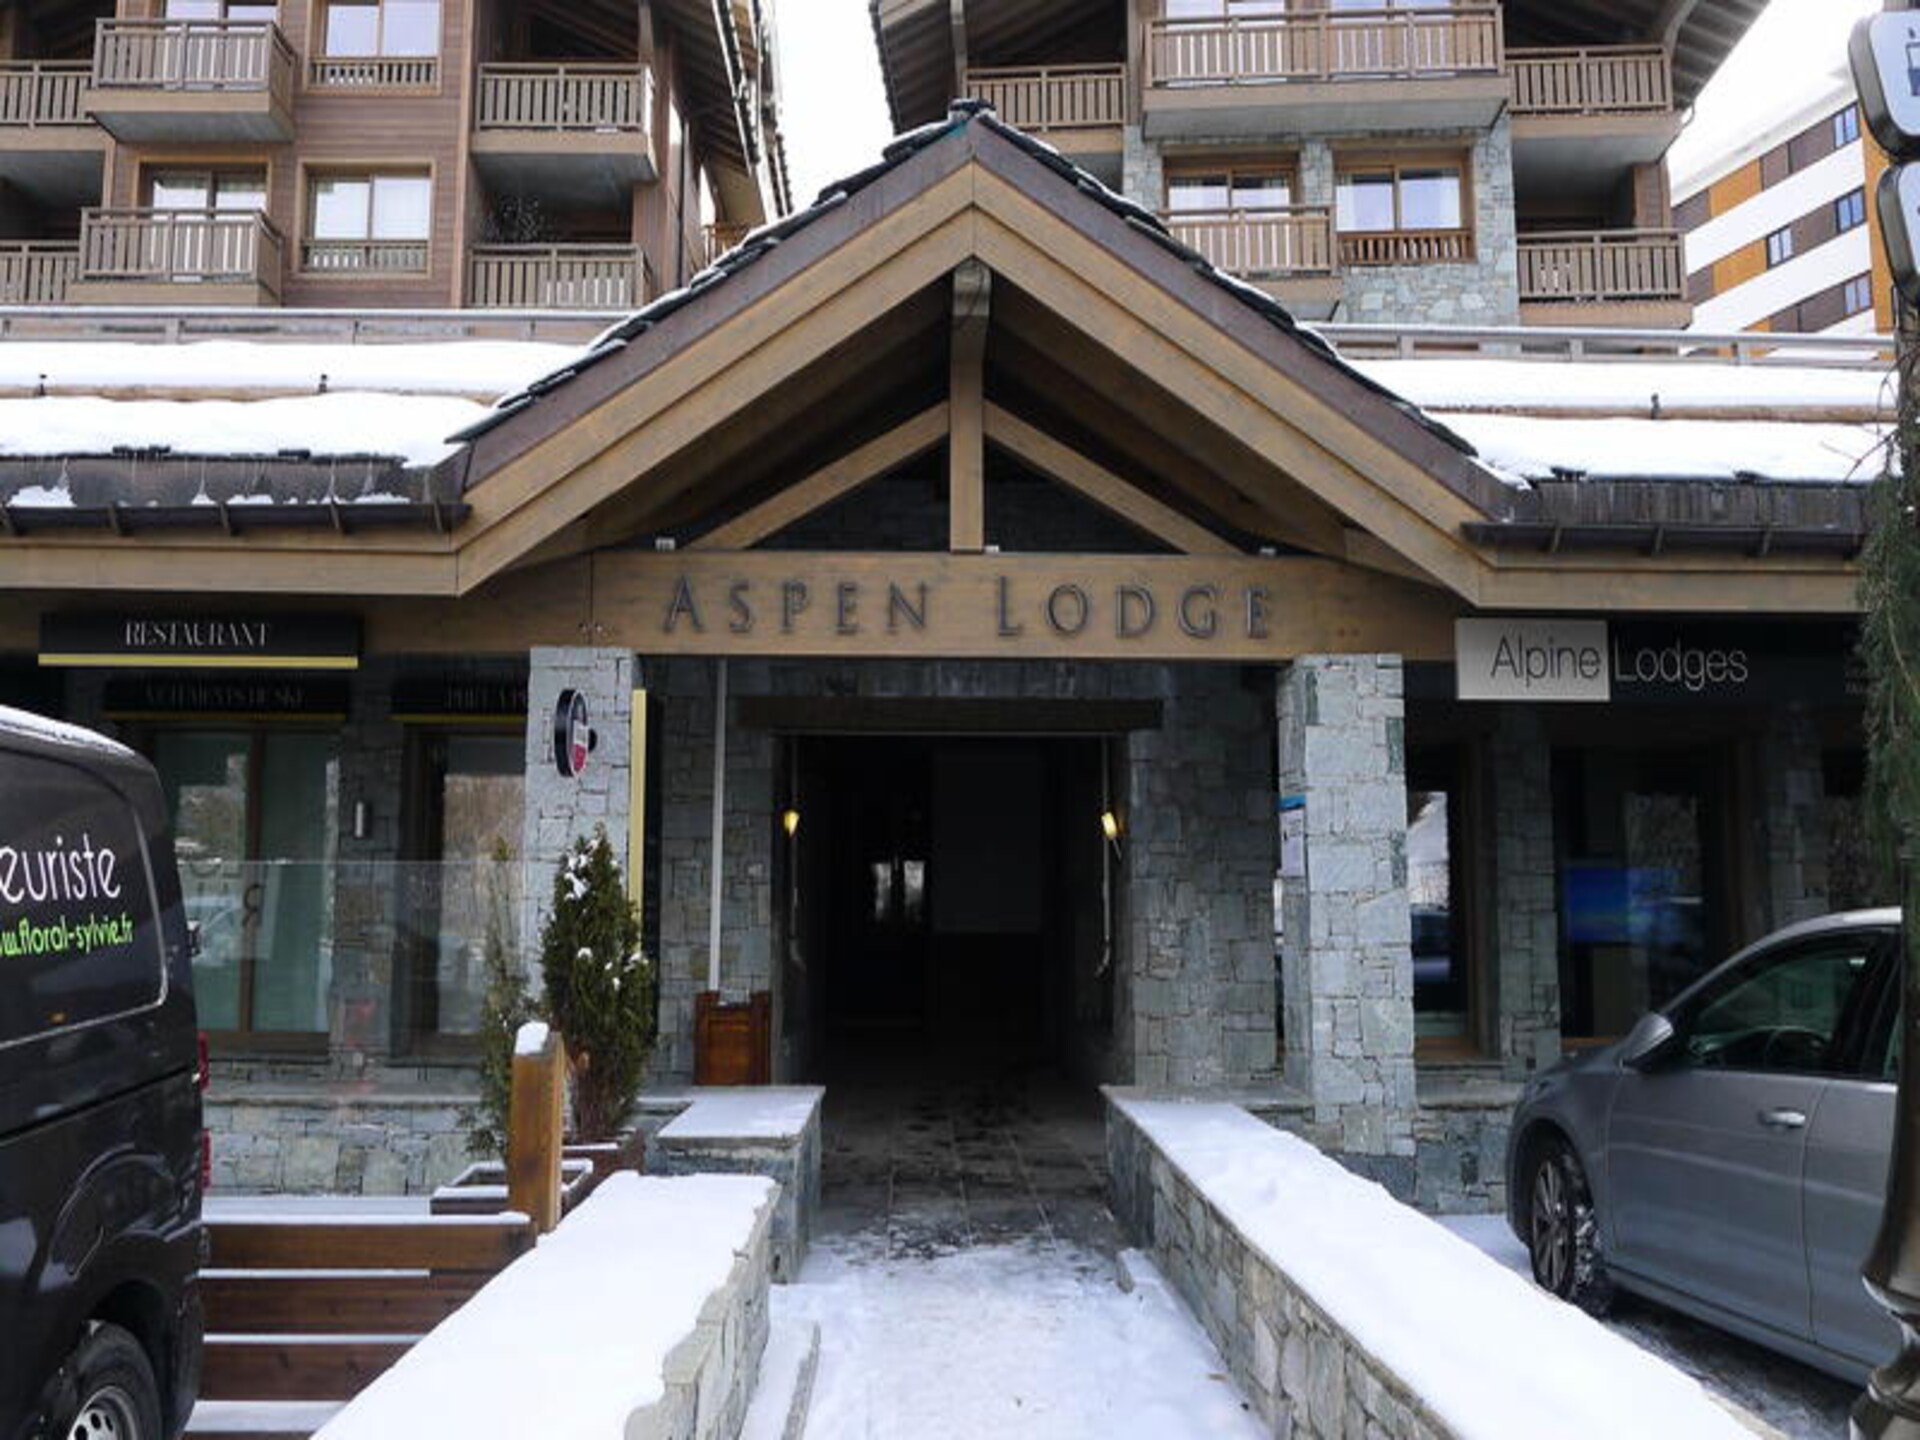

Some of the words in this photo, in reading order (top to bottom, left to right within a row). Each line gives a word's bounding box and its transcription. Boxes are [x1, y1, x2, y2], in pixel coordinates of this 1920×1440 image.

[663, 575, 930, 636] ASPEN
[996, 577, 1276, 640] LODGE
[125, 622, 271, 646] RESTAURANT
[1490, 635, 1601, 688] Alpine
[1614, 636, 1749, 692] Lodges
[0, 912, 133, 957] w.floral-sylvie.fr
